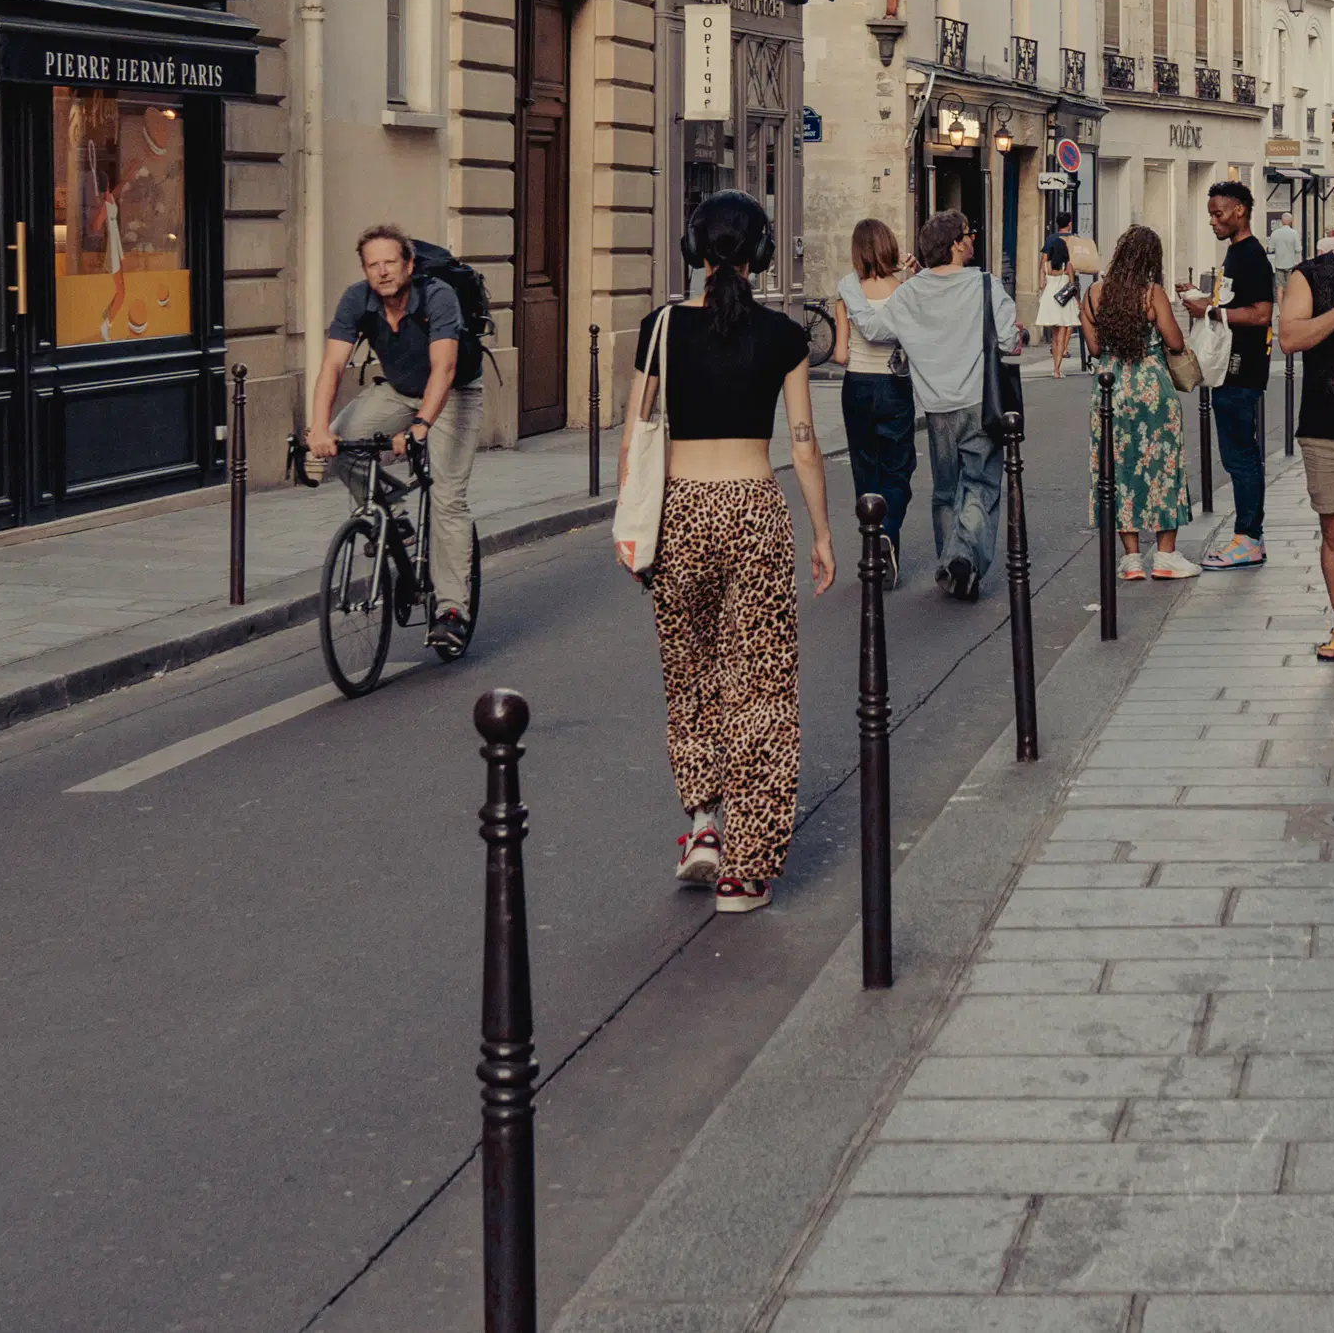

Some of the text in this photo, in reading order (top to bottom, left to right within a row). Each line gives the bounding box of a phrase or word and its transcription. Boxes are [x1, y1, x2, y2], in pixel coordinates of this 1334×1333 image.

[45, 51, 223, 88] PIERRE HERMÉ PARIS
[702, 17, 713, 109] Optique
